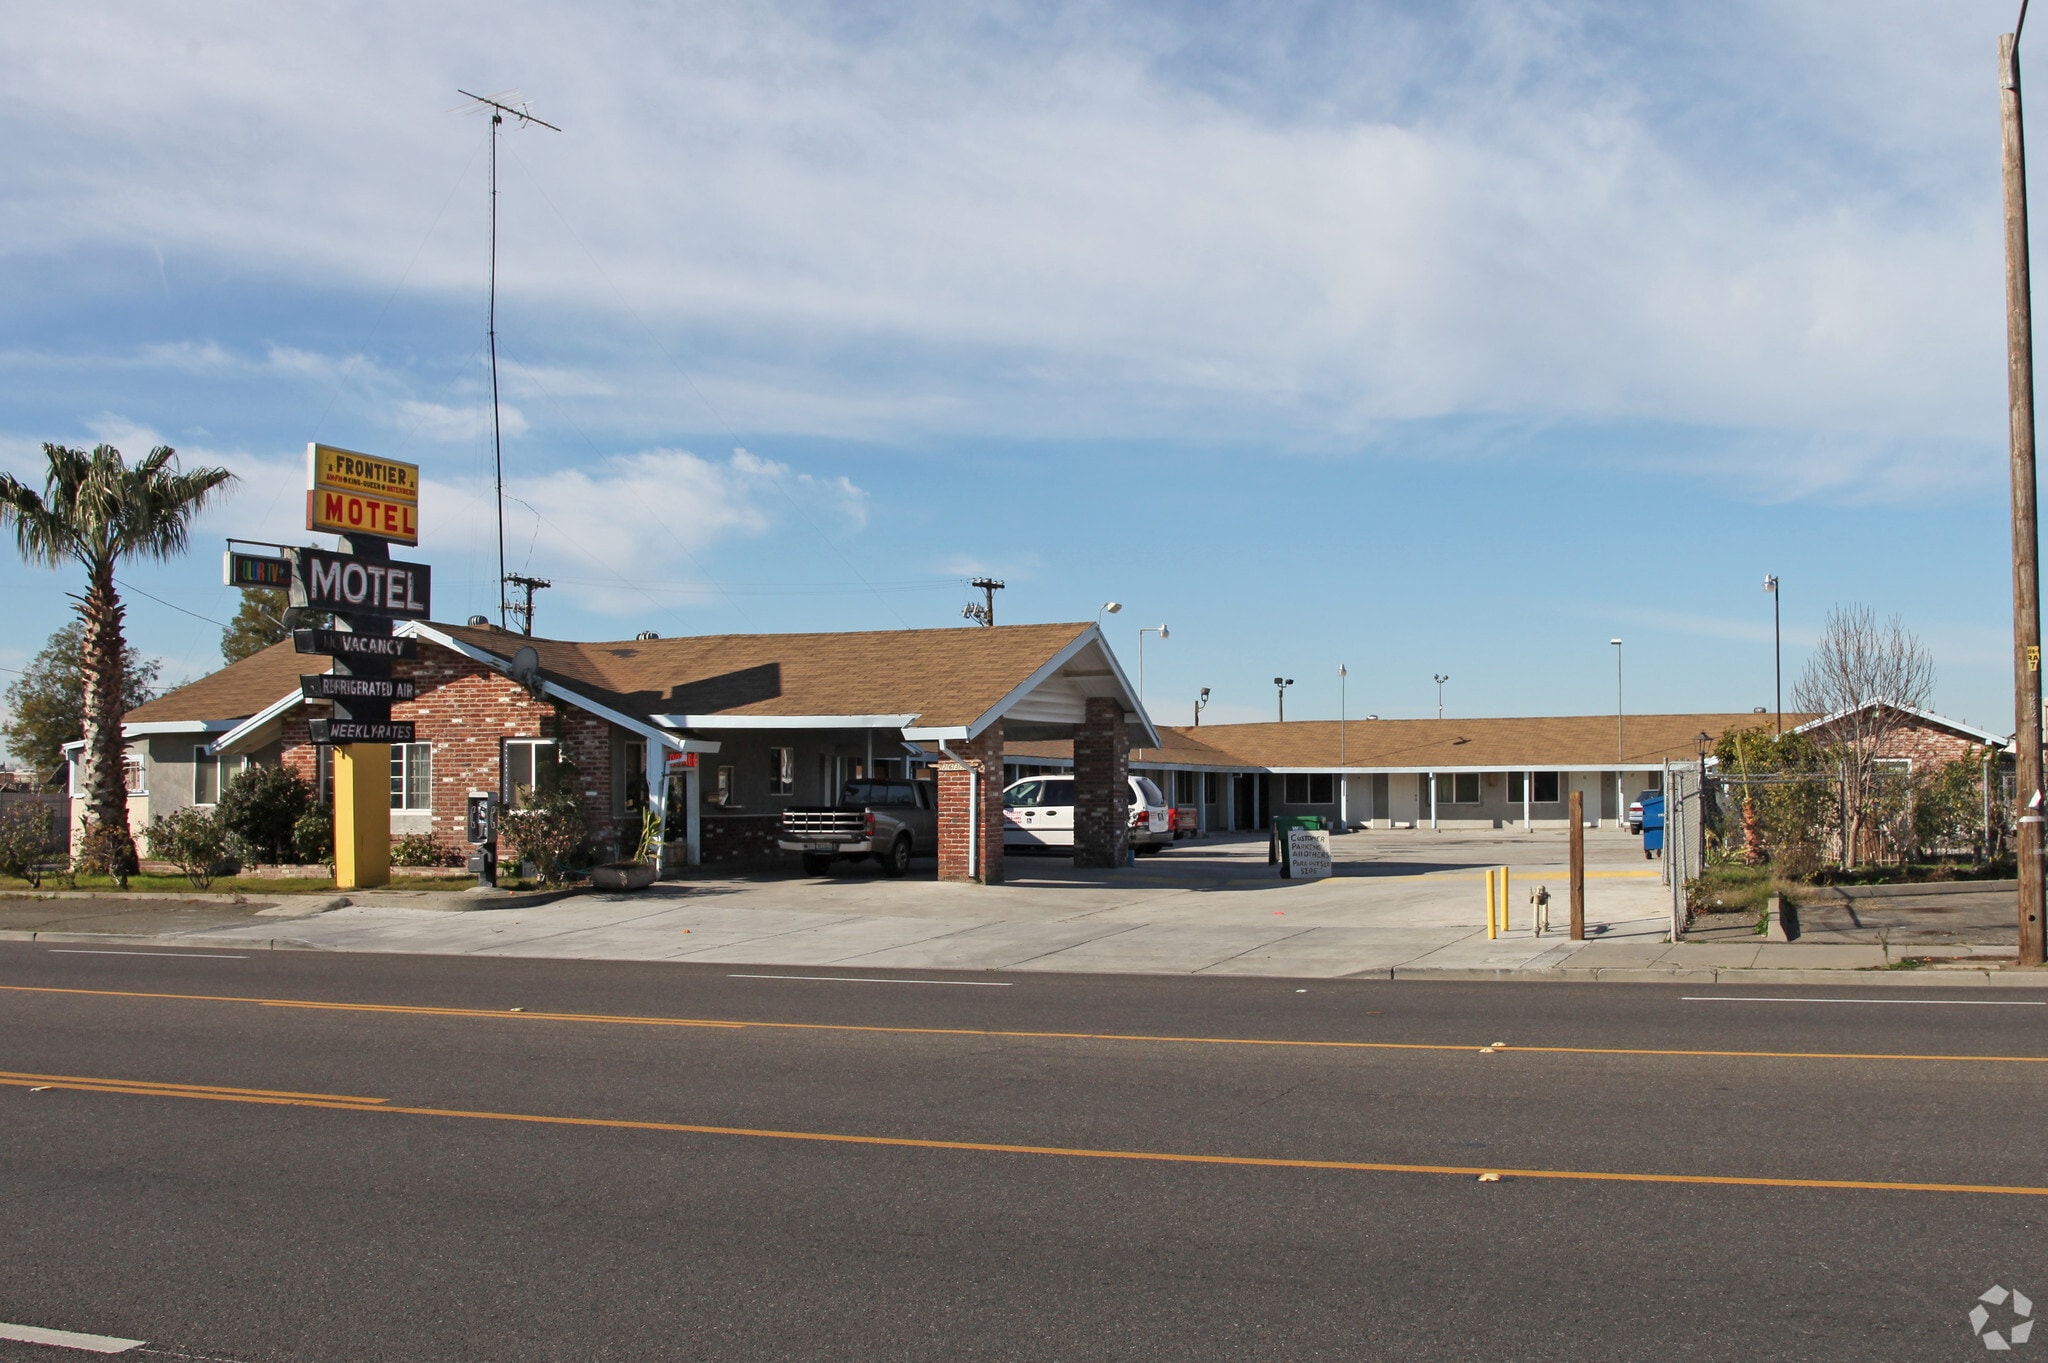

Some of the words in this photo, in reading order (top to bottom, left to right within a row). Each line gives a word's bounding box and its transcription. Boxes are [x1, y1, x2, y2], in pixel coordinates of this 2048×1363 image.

[336, 455, 406, 485] FRONTIER
[325, 493, 415, 535] MOTEL
[237, 558, 265, 582] COLOR
[267, 562, 279, 583] TV
[311, 558, 424, 610] MOTEL
[342, 636, 405, 656] VACANCY
[2030, 661, 2036, 669] 7
[323, 679, 393, 697] REFRIGERATED
[396, 682, 414, 698] AIR
